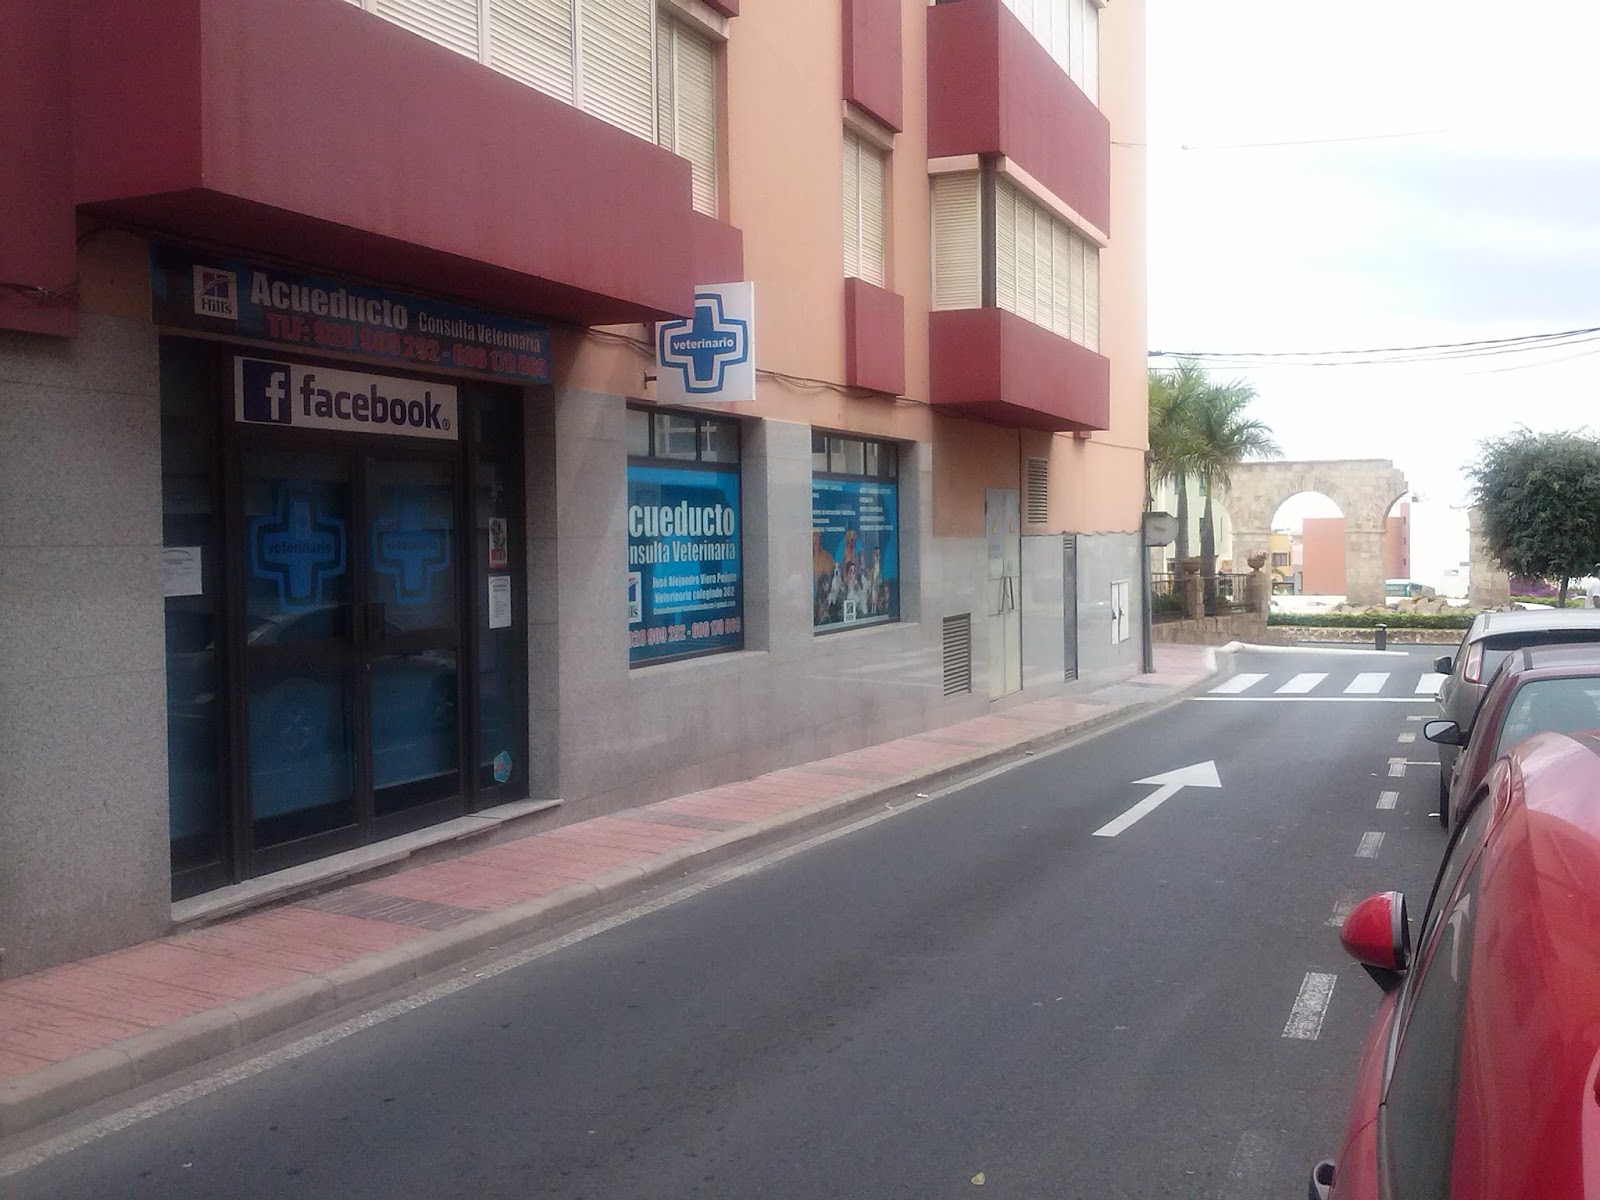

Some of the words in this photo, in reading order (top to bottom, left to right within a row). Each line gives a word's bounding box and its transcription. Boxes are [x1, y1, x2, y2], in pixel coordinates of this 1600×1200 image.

[250, 271, 408, 331] Acueducto
[418, 311, 475, 341] Consulta
[477, 324, 542, 355] Veterinaria
[673, 337, 735, 350] veterinario
[628, 500, 735, 537] cueducto
[629, 541, 670, 565] nsulta
[672, 539, 736, 563] Veterinaria
